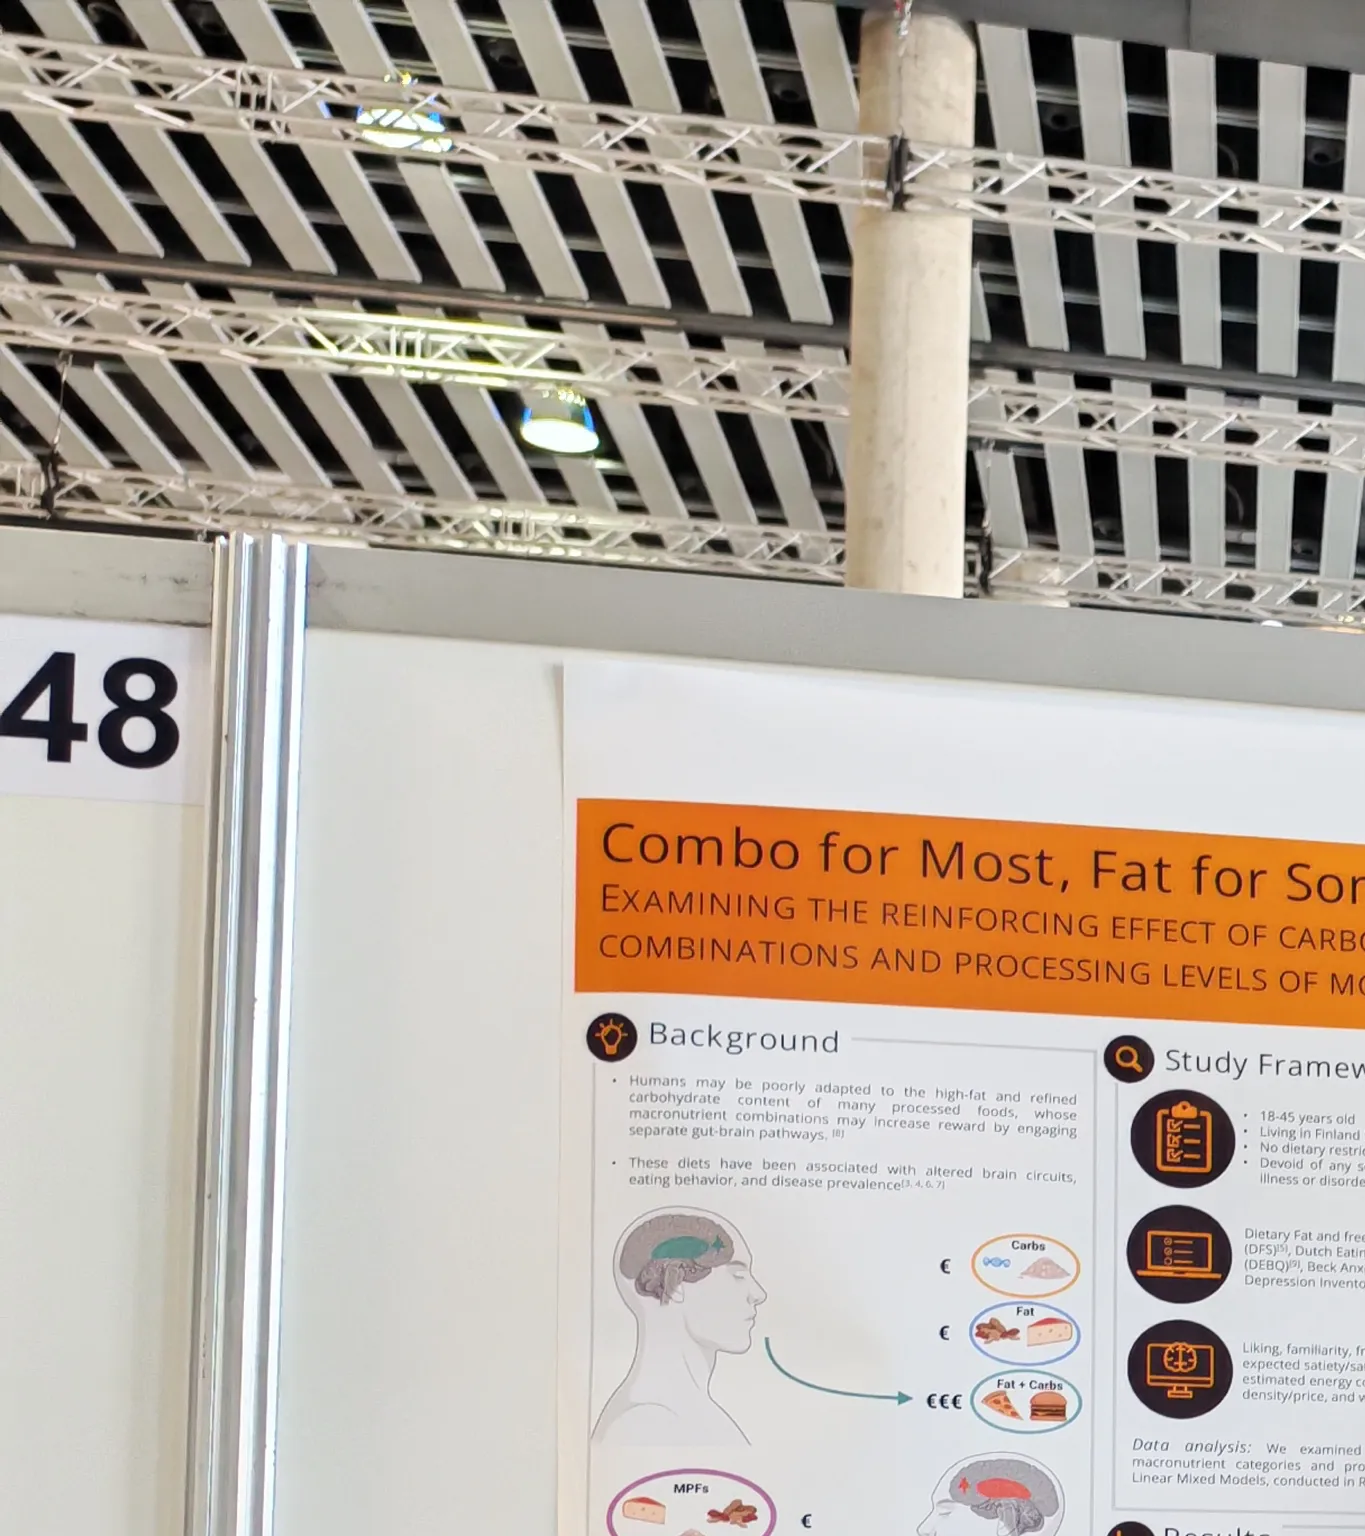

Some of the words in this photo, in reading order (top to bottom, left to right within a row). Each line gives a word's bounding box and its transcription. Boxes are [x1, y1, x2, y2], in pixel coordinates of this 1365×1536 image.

[0, 651, 180, 769] 48
[603, 823, 799, 869] Combo
[819, 831, 898, 875] for
[922, 840, 1068, 893] Most,
[1094, 851, 1171, 893] Fat
[1192, 855, 1267, 898] for
[602, 884, 794, 919] EXAMINING
[808, 898, 867, 923] THE
[883, 903, 1098, 937] REINFORCING
[1113, 916, 1215, 944] EFFECT
[1228, 924, 1272, 946] OF
[600, 935, 858, 968] COMBINATIONS
[871, 948, 940, 972] AND
[956, 952, 1149, 985] PROCESSING
[1164, 964, 1267, 991] LEVELS
[1280, 971, 1317, 993] OF
[651, 1022, 838, 1054] Background
[1166, 1050, 1247, 1080] Study
[629, 1074, 686, 1088] Humans
[695, 1078, 726, 1092] may
[735, 1077, 753, 1090] be
[761, 1080, 806, 1096] poorly
[814, 1082, 871, 1097] adapted
[881, 1086, 895, 1097] to
[904, 1086, 926, 1098] the
[935, 1087, 986, 1103] high-fat
[995, 1091, 1021, 1103] and
[1030, 1092, 1077, 1106] refined
[1261, 1110, 1296, 1123] 18-45
[1298, 1114, 1333, 1127] years
[1335, 1113, 1356, 1126] old
[1260, 1126, 1297, 1142] Living
[1299, 1127, 1312, 1139] in
[1315, 1128, 1361, 1141] Finland
[1011, 1240, 1046, 1252] Carbs
[1016, 1306, 1035, 1317] Fat
[996, 1378, 1015, 1390] Fat
[1019, 1381, 1026, 1389] +
[1028, 1379, 1063, 1391] Carbs
[673, 1483, 709, 1494] MPFs
